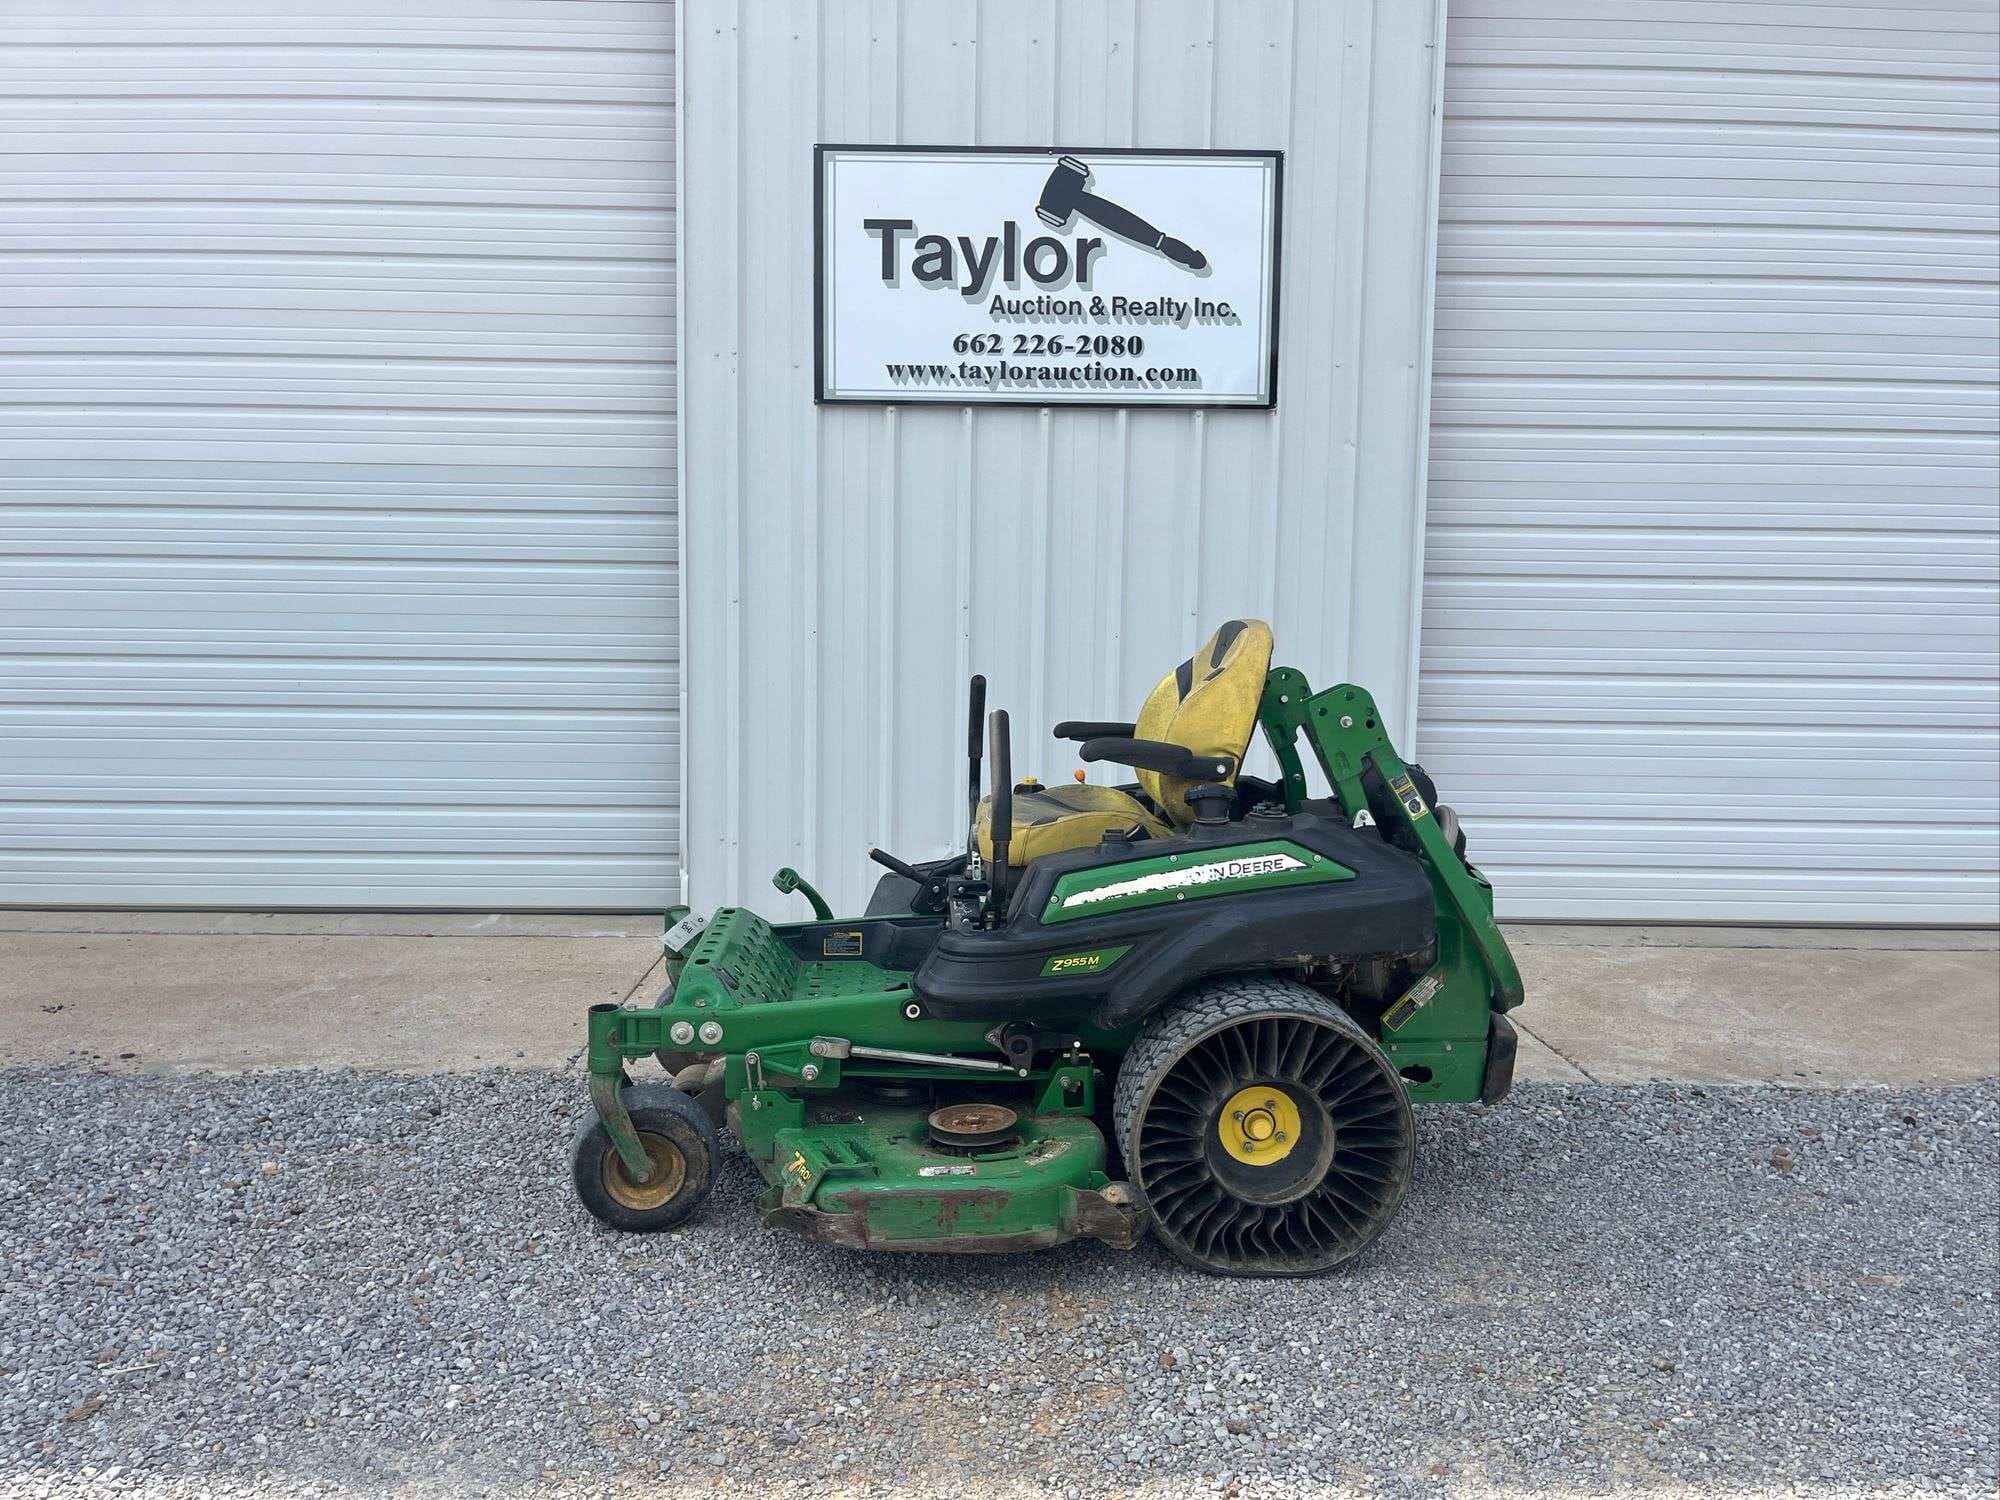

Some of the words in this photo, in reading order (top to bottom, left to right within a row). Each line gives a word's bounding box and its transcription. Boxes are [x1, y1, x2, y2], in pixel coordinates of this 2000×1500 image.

[863, 218, 1102, 295] Taylor
[990, 295, 1081, 316] Auction
[1089, 296, 1105, 317] &
[1112, 297, 1187, 321] Realty
[1195, 298, 1237, 318] Inc.
[953, 334, 1001, 354] 662
[1013, 335, 1143, 355] 226-2080
[886, 361, 1197, 385] www.taylorauction.com
[1228, 858, 1284, 876] DEERE
[1052, 955, 1100, 971] Z955M
